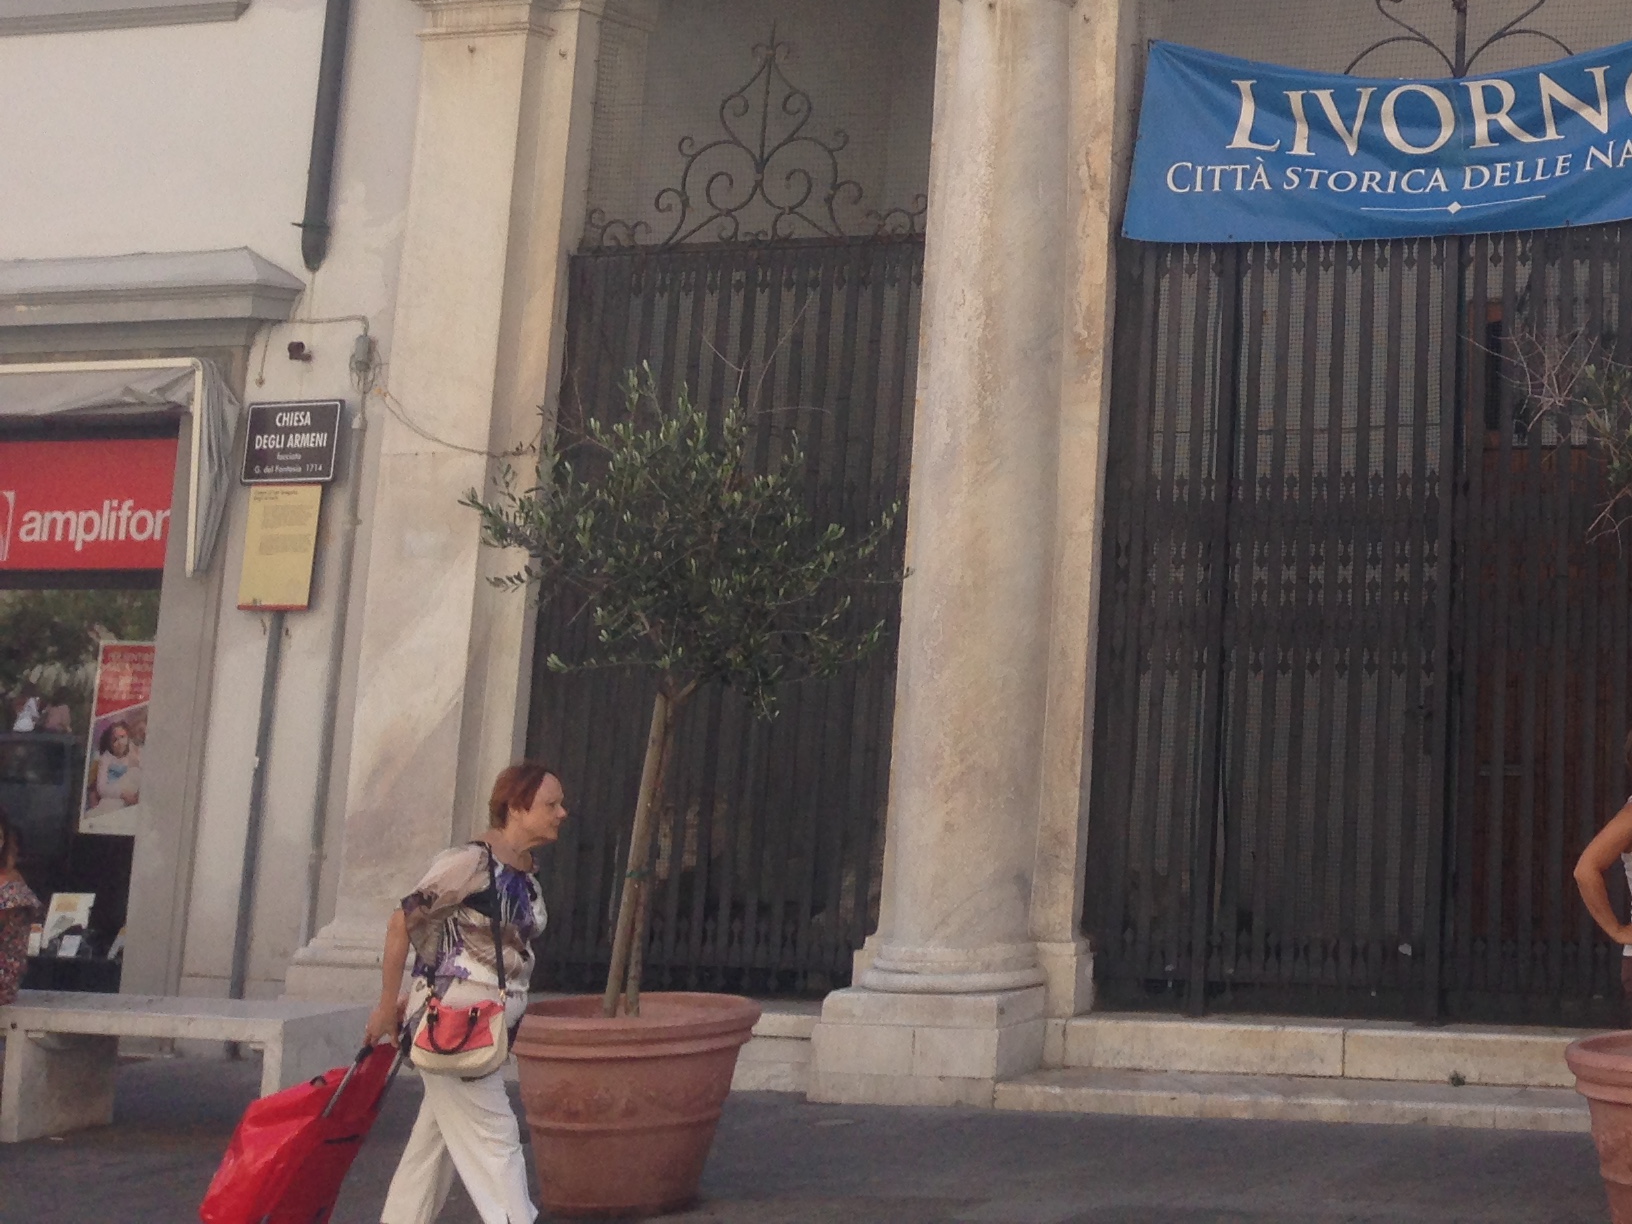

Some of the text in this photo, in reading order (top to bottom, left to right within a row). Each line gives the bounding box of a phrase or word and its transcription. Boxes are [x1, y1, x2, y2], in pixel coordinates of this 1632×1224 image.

[1166, 156, 1270, 194] CITTÀ
[1283, 166, 1450, 194] STORICA
[1462, 154, 1571, 191] DELLE
[276, 411, 311, 427] CHIESA
[255, 432, 327, 449] DEGLI ARMENI
